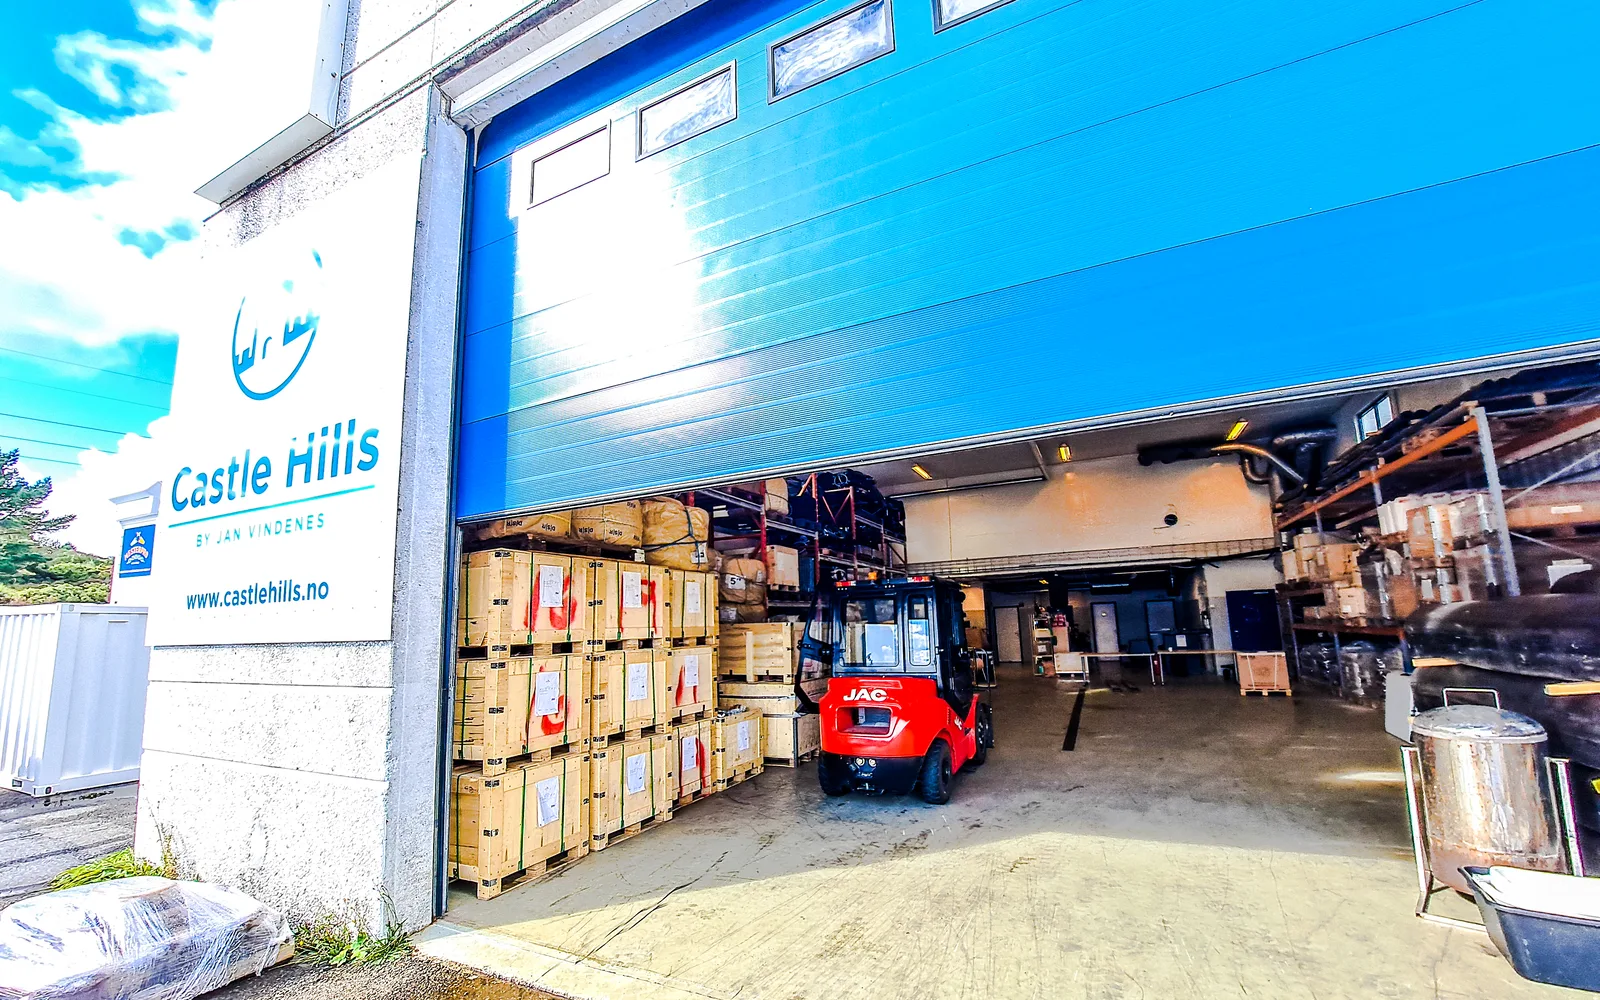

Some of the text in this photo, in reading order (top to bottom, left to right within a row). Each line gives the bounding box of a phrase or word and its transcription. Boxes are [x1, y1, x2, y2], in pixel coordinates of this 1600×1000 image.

[171, 418, 379, 512] Castle Hills
[196, 513, 325, 548] BY JAN VINDENES
[186, 579, 329, 609] www.castlehills.no
[843, 688, 887, 702] JAC
